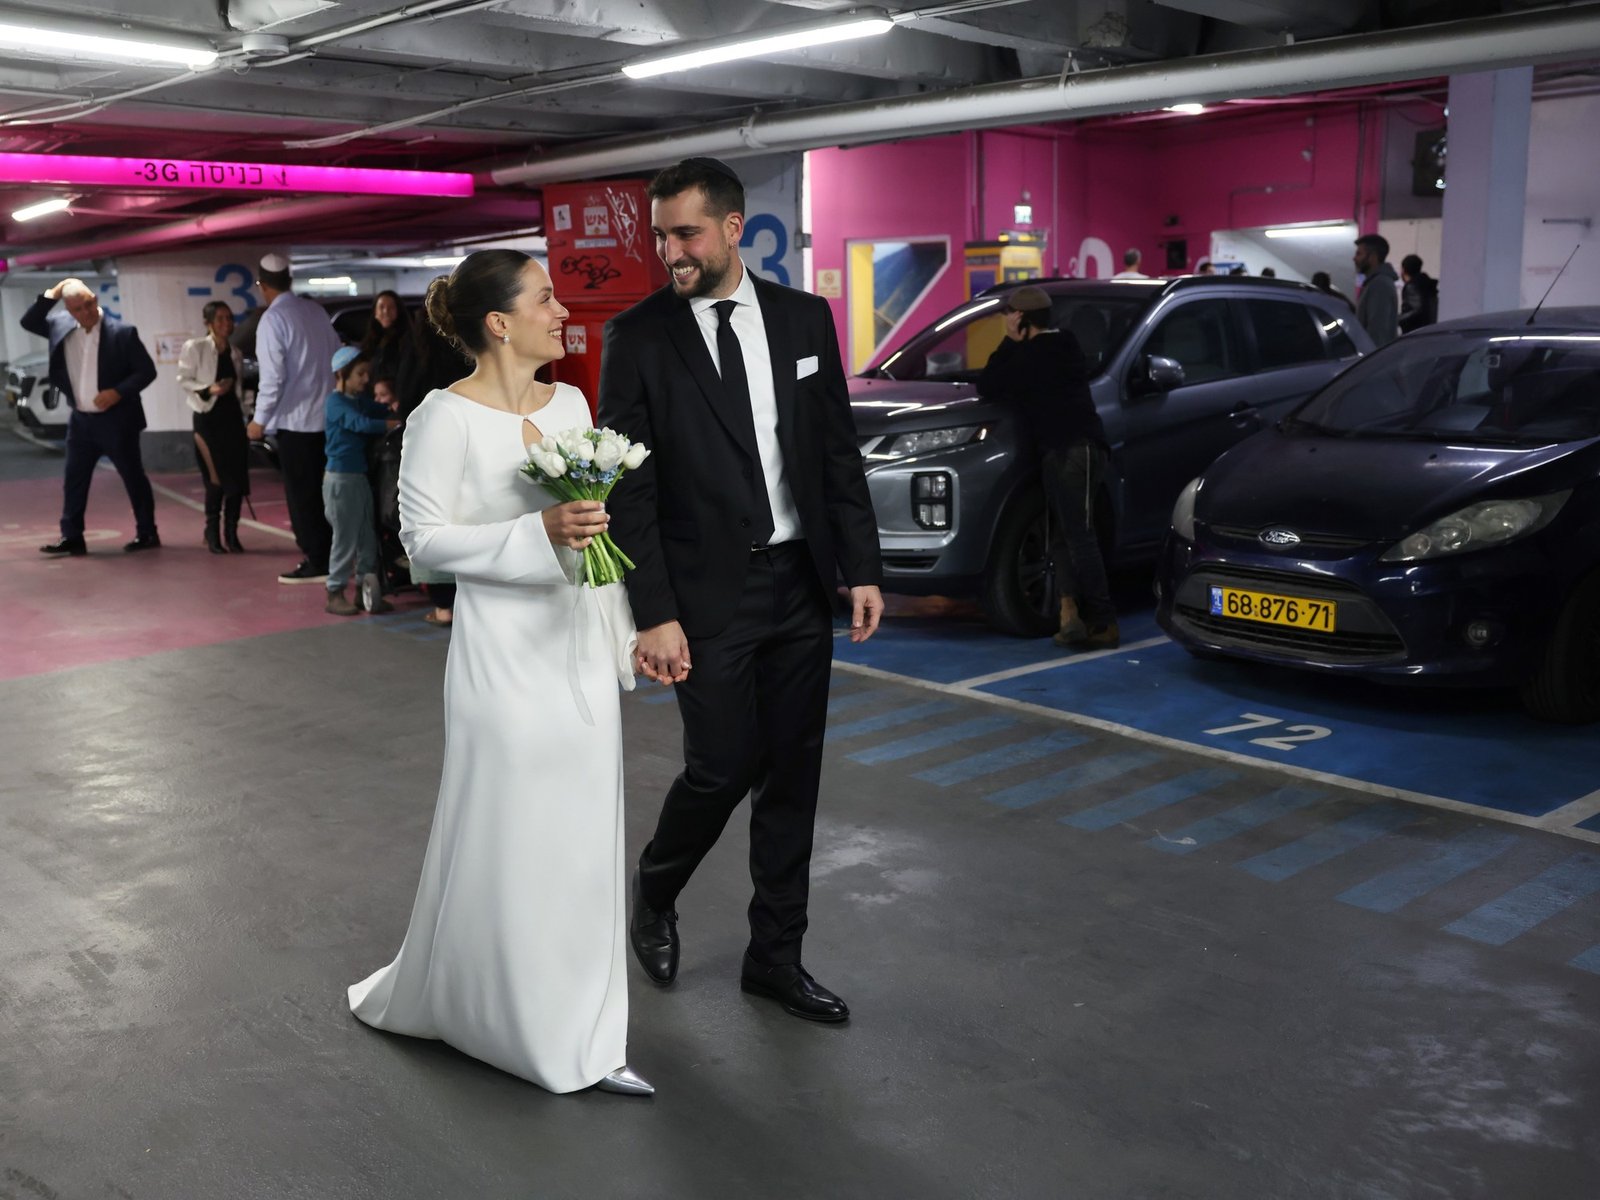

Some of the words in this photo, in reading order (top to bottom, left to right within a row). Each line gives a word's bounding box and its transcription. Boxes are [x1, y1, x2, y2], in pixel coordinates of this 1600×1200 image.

[190, 164, 262, 185] כניסה
[585, 214, 607, 226] אש
[568, 334, 585, 345] אש
[1201, 712, 1333, 751] 72
